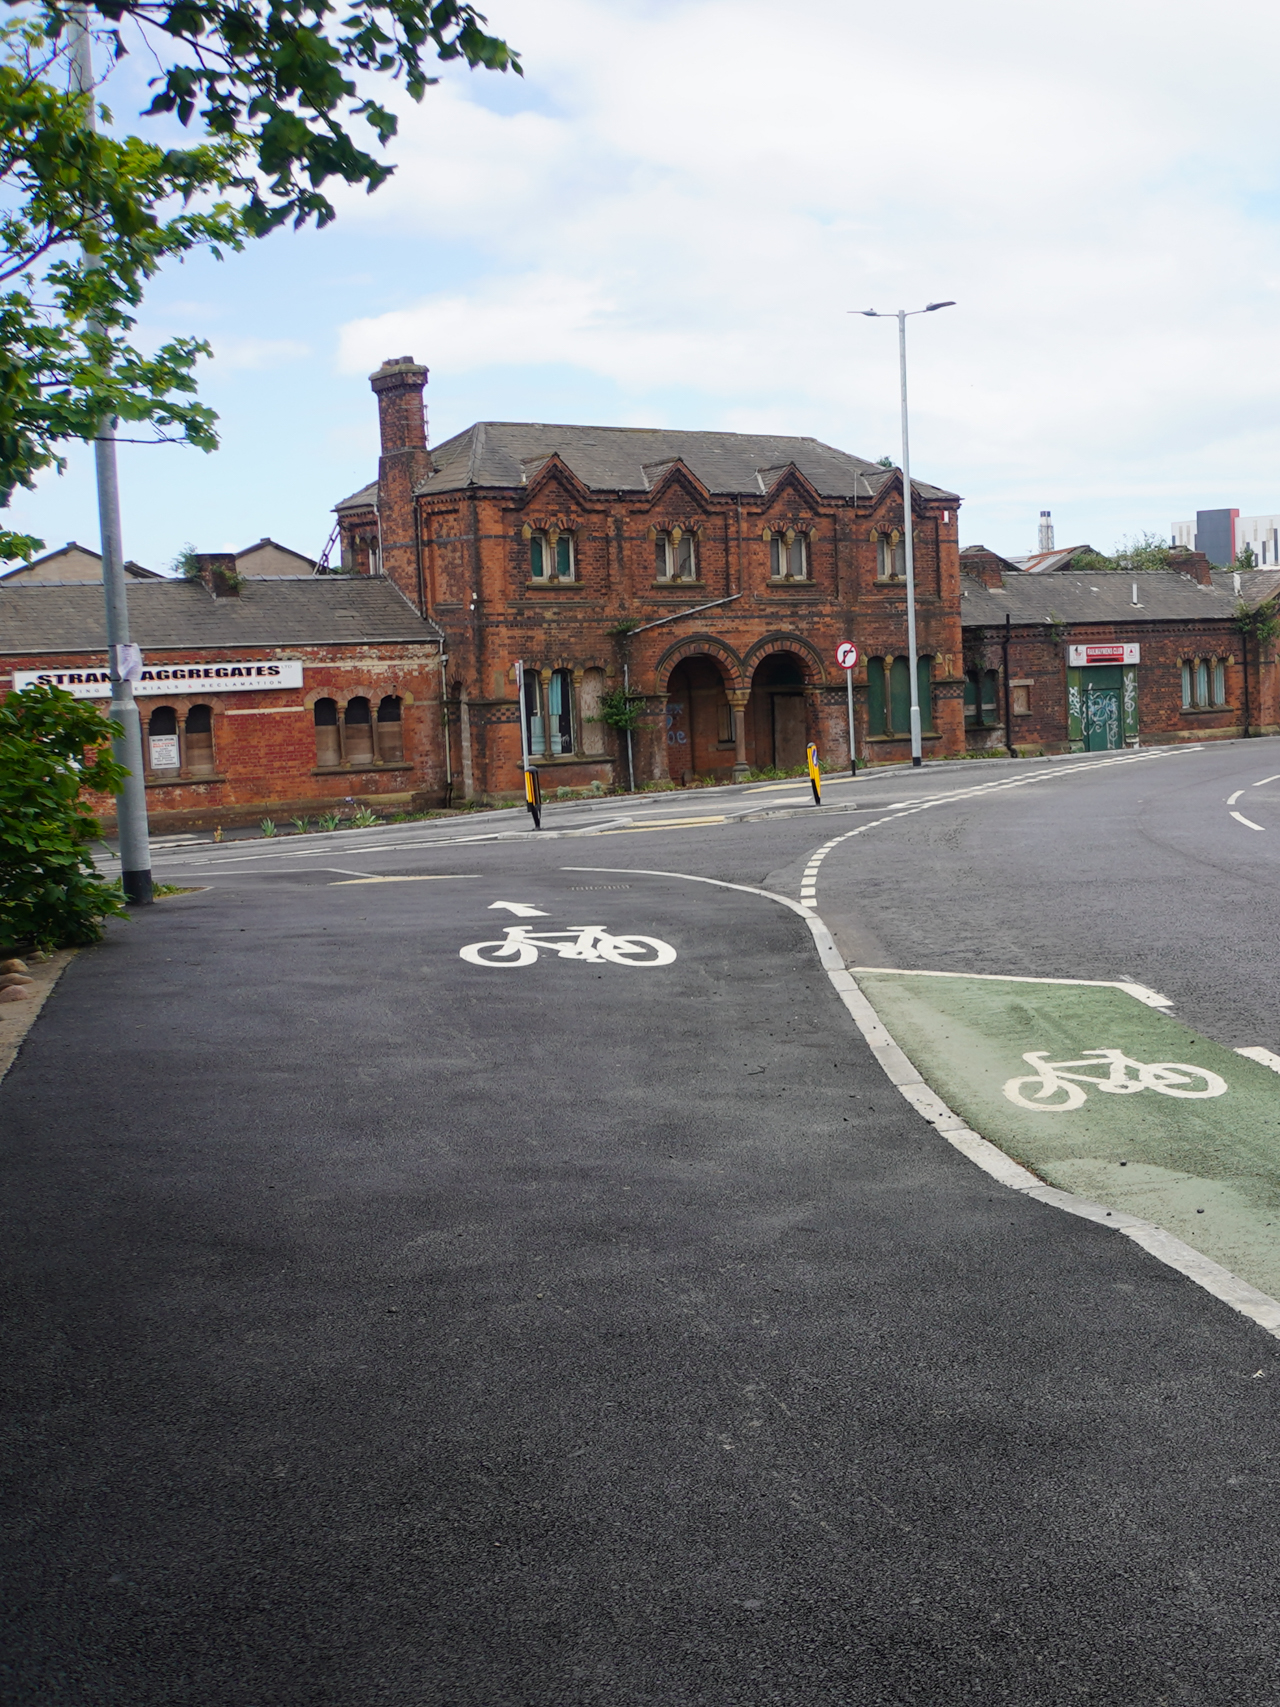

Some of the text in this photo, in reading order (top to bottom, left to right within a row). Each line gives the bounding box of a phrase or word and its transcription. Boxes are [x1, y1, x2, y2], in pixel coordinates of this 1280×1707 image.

[37, 672, 112, 685] STRAN
[140, 665, 281, 681] AGGREGATES
[201, 680, 283, 688] RECLAMATION
